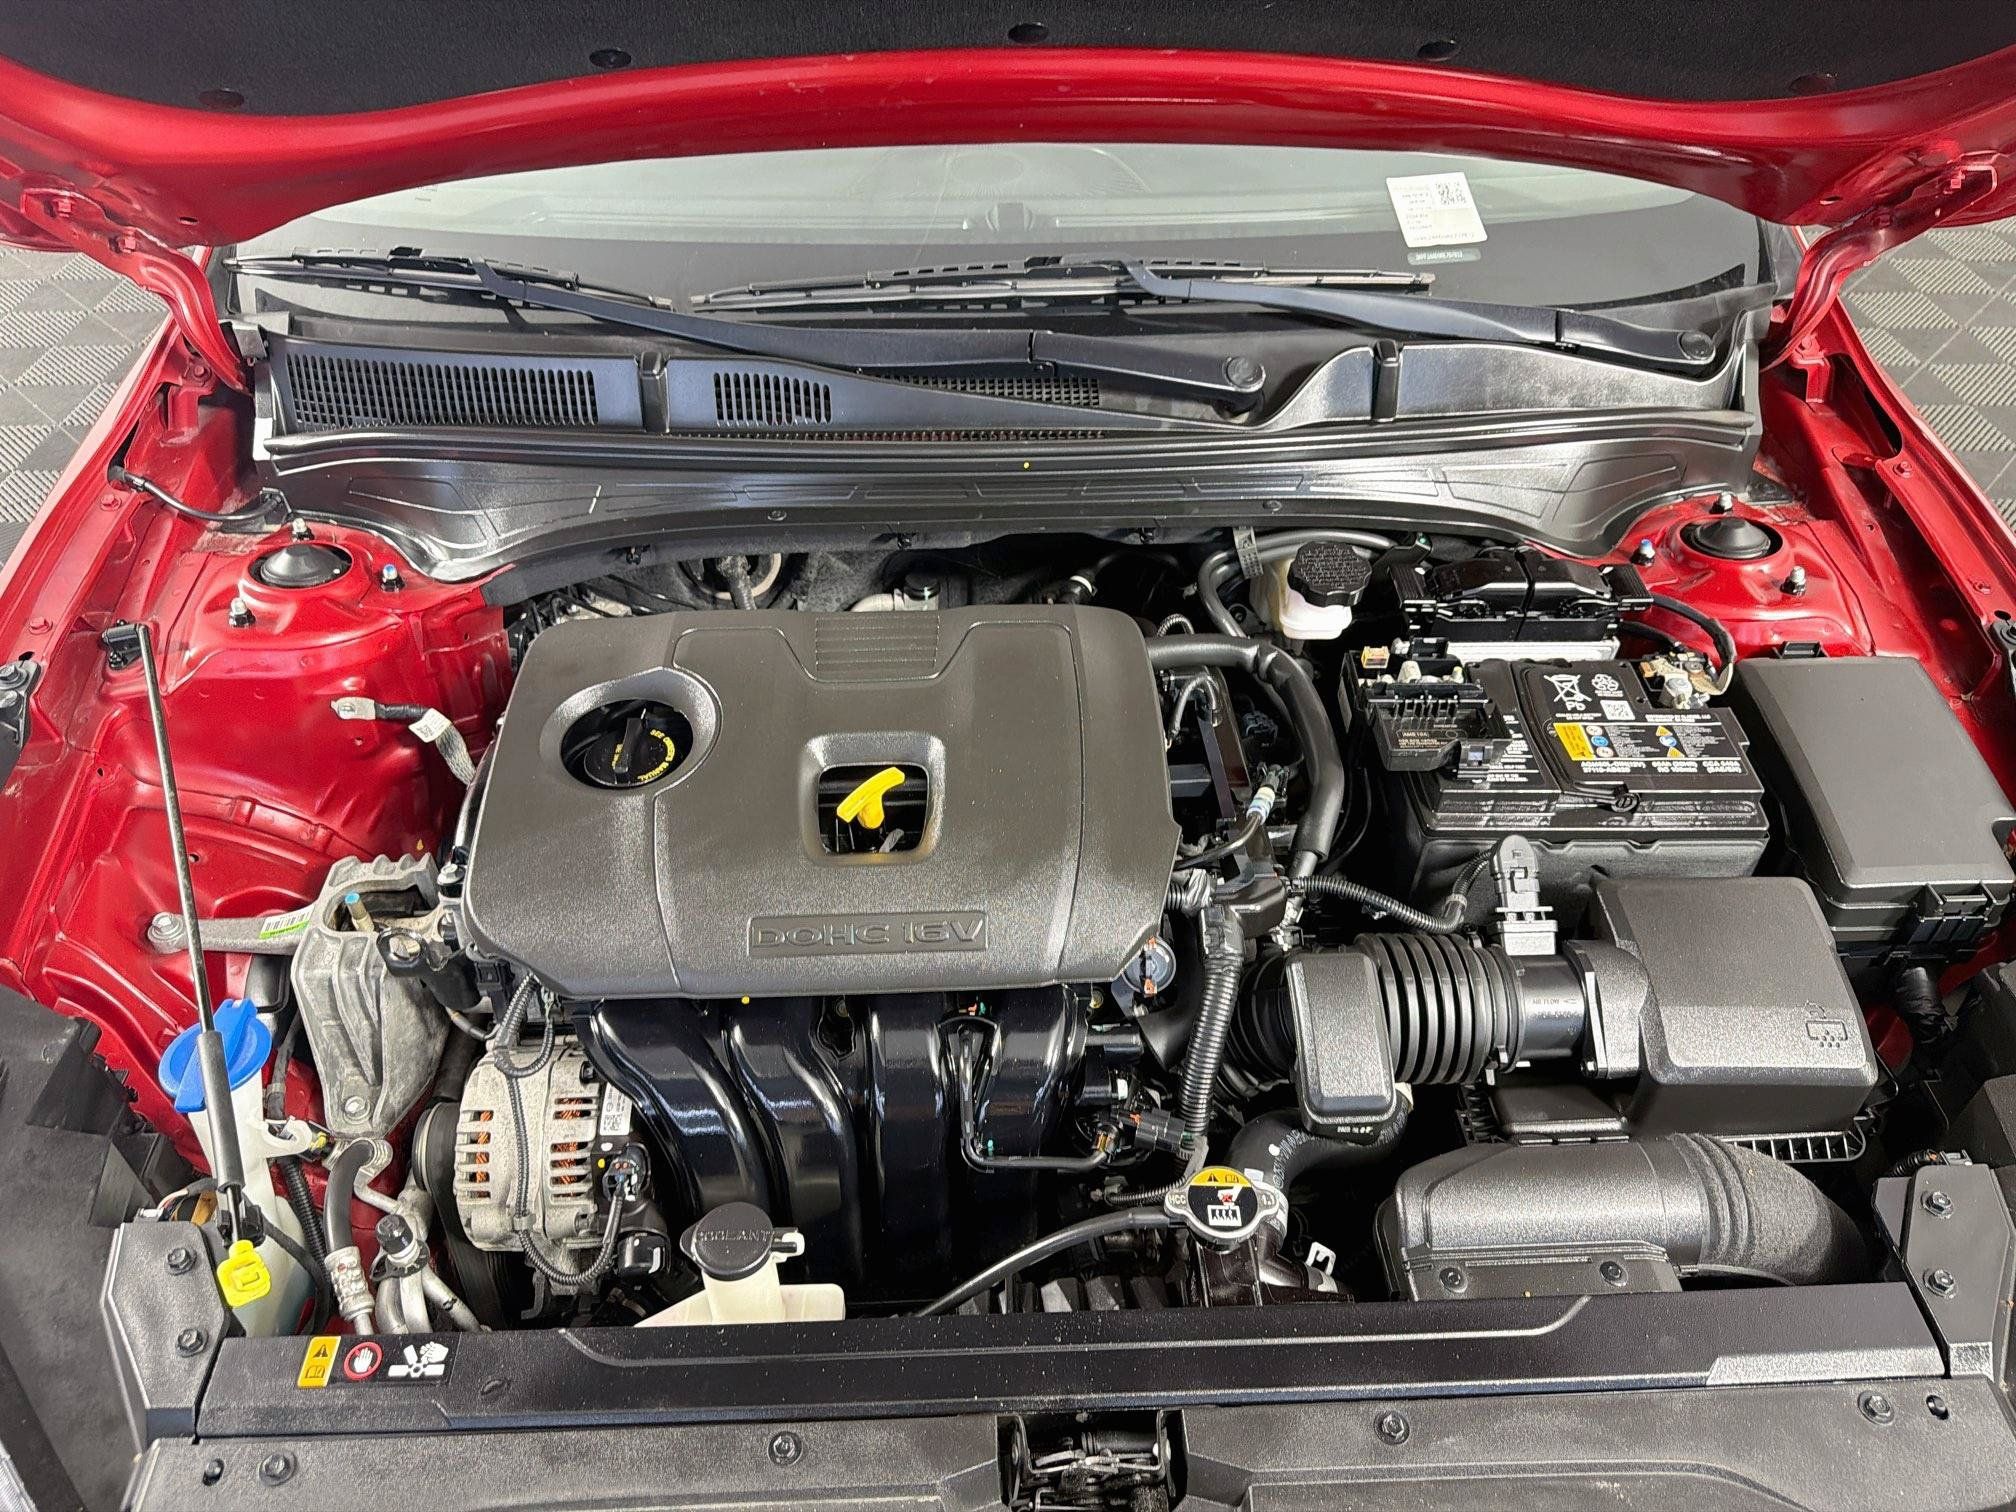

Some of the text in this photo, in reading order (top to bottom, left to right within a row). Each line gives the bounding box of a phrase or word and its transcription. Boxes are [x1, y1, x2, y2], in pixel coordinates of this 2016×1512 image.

[1565, 701, 1586, 711] Pb
[752, 918, 984, 948] DOHC 16V
